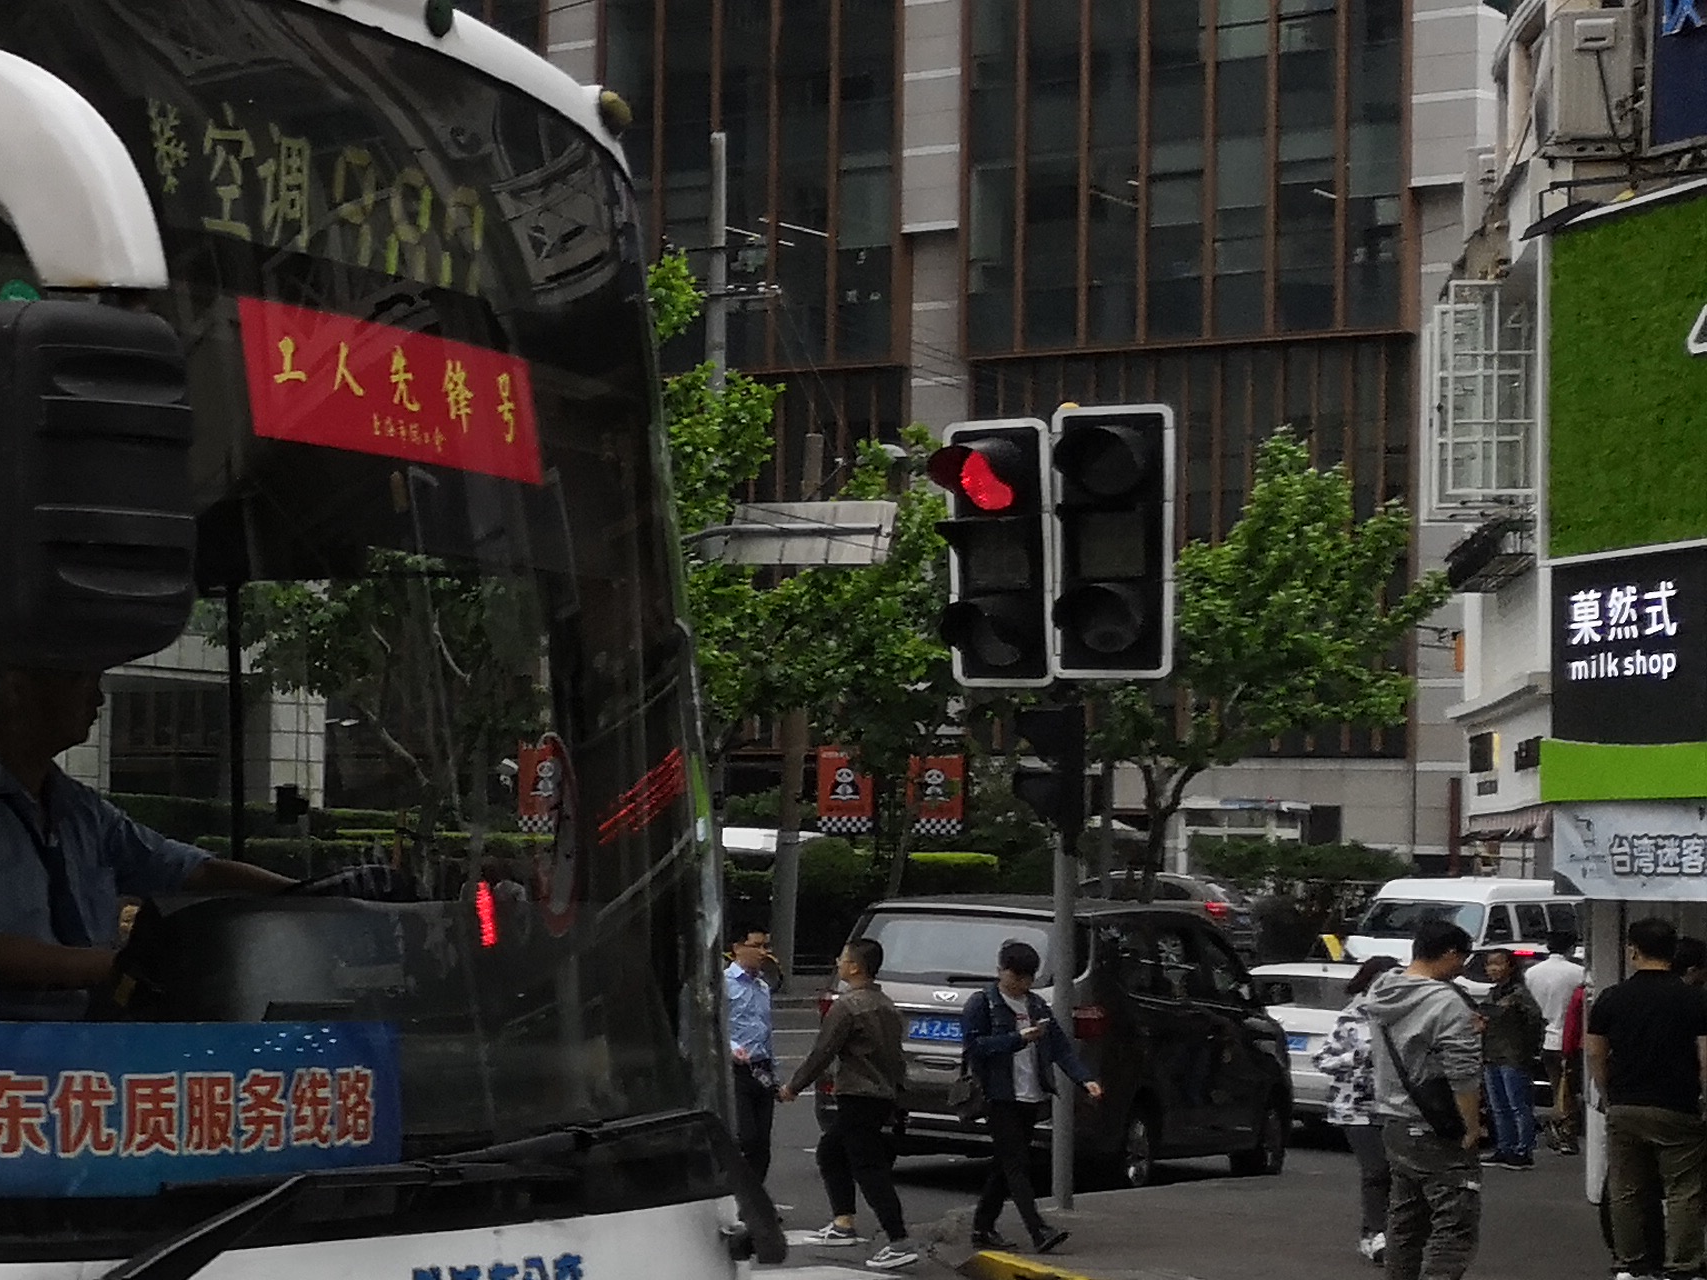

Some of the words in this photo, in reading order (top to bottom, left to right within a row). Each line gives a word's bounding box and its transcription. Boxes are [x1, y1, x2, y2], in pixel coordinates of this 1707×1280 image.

[202, 101, 312, 252] 空调
[274, 336, 516, 444] 工人先锋号
[1569, 651, 1619, 681] milk
[1623, 648, 1678, 681] shop
